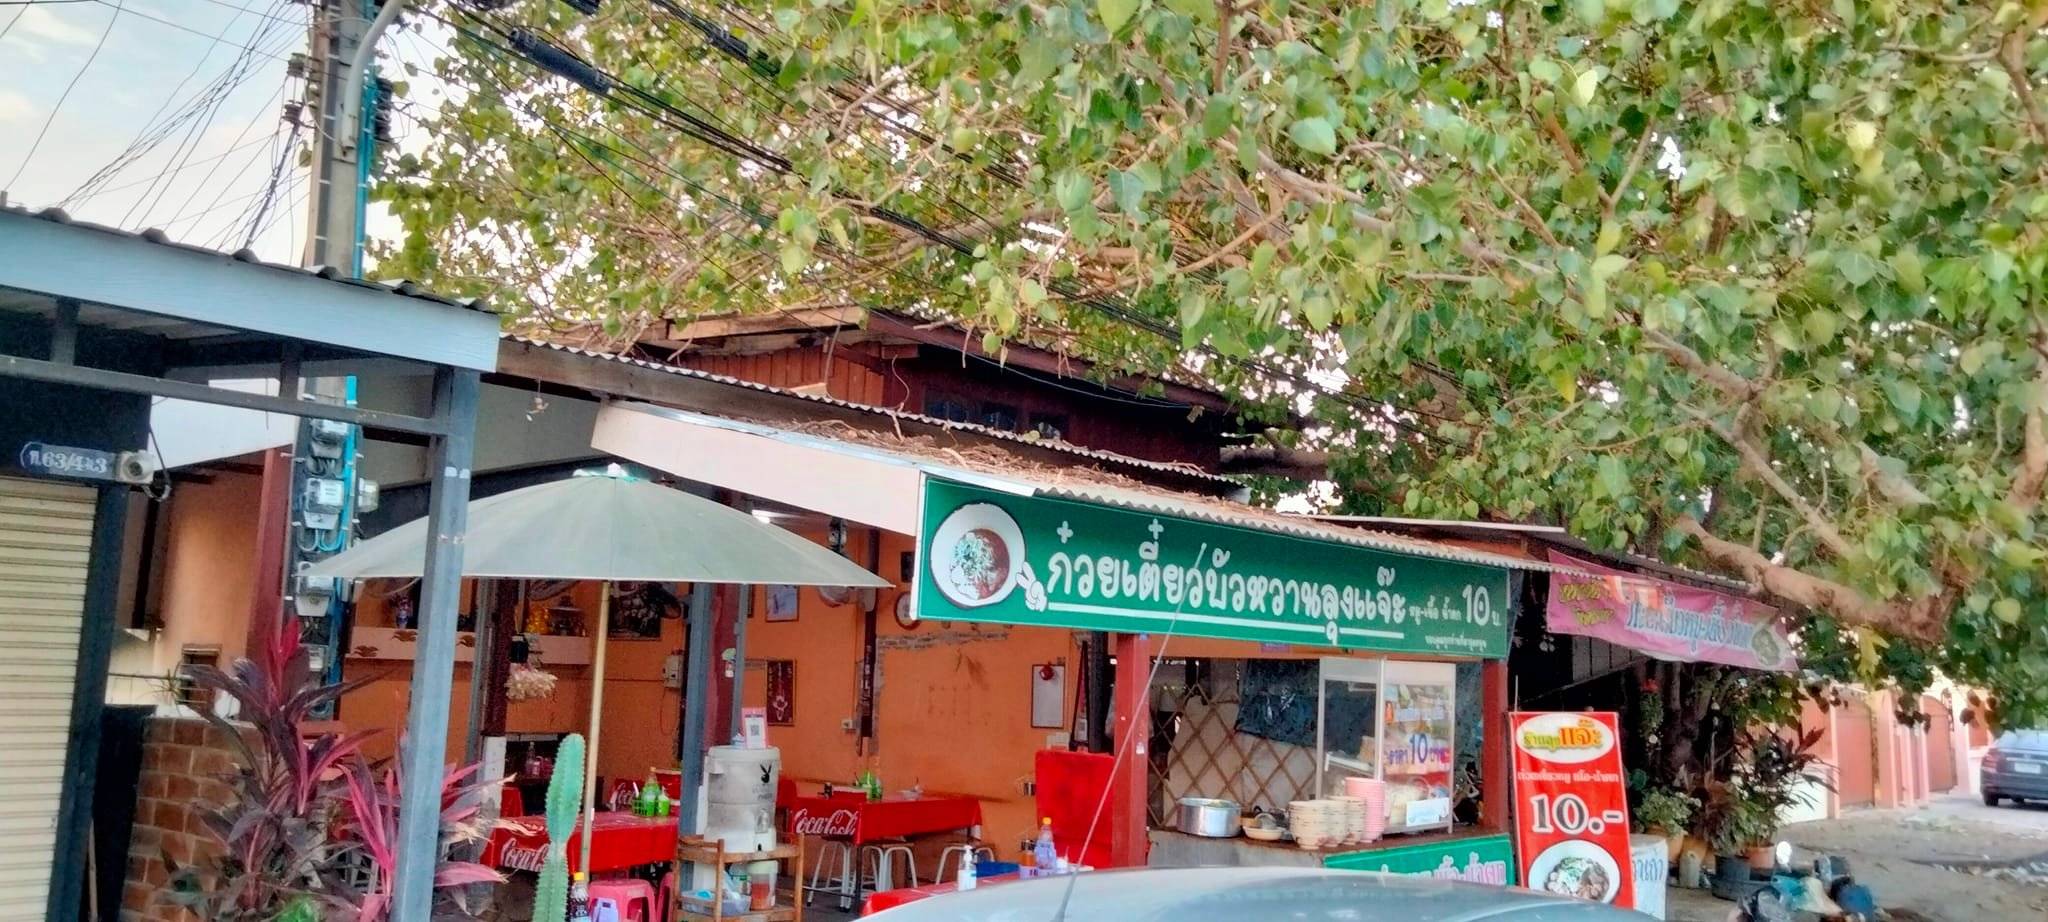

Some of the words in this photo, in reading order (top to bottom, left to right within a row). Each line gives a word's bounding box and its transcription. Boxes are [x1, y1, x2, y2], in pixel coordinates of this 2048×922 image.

[1462, 584, 1490, 626] 10
[1409, 733, 1428, 764] 10
[1530, 793, 1624, 835] 10.-
